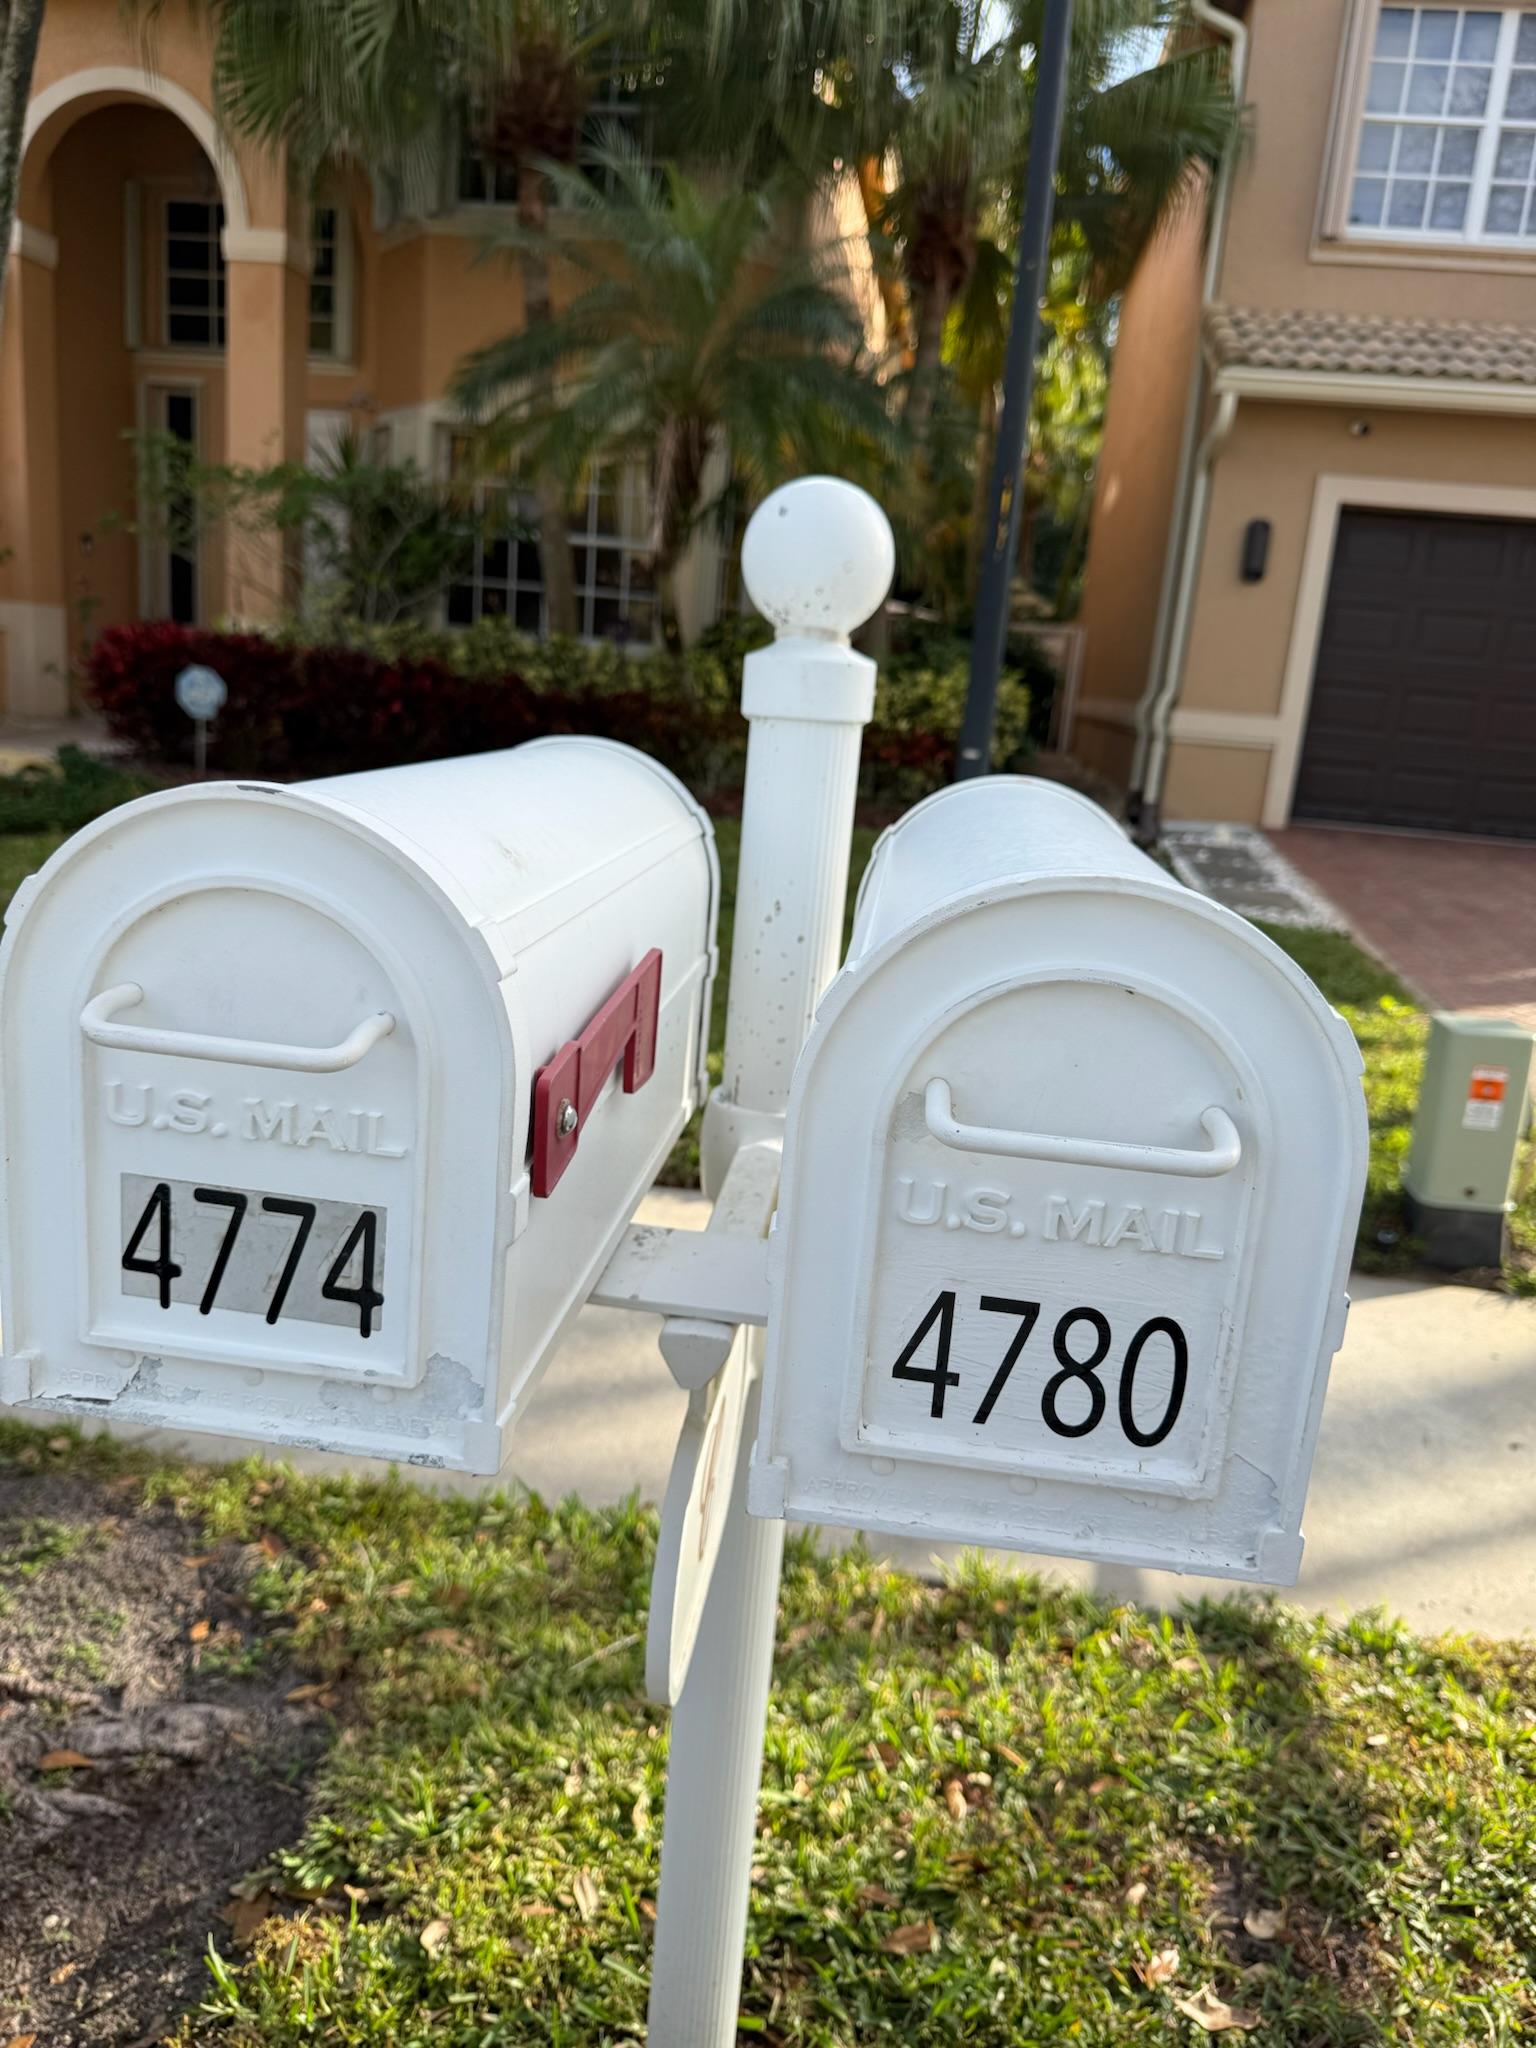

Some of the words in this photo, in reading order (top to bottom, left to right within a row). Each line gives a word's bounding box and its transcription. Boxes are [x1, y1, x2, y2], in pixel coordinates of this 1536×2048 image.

[104, 1081, 228, 1138] U.S.
[243, 1097, 408, 1158] MAIL
[121, 1182, 385, 1339] 4774
[900, 1177, 1026, 1238] U.S.
[1042, 1194, 1225, 1261] MAIL
[891, 1290, 1189, 1448] 4780
